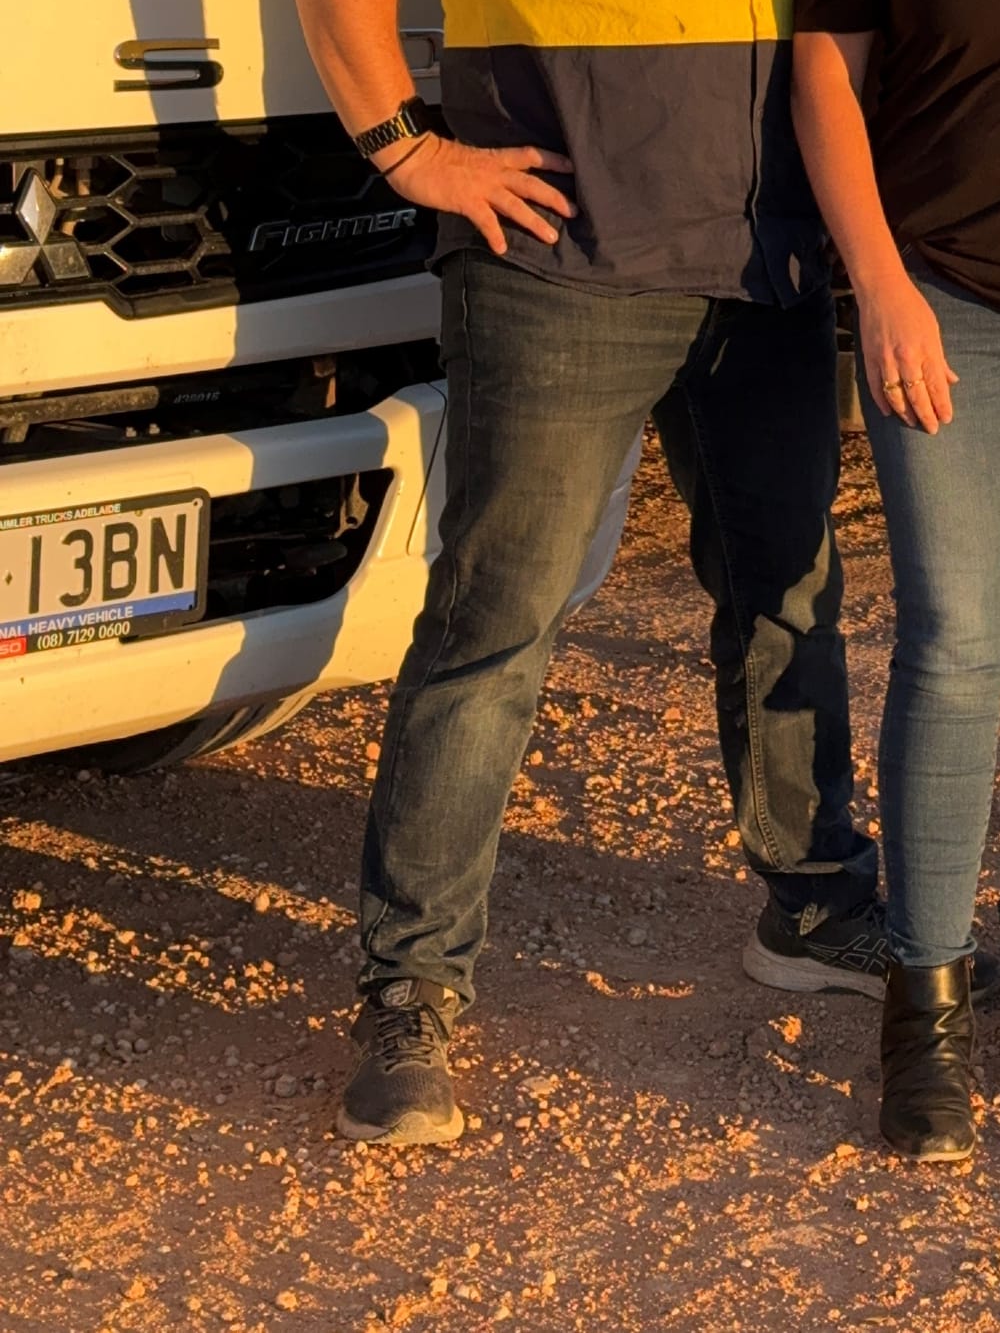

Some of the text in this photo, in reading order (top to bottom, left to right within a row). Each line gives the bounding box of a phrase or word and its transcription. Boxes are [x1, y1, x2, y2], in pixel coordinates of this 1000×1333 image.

[35, 510, 73, 525] TRUCKS
[73, 503, 122, 520] ADELAIDE
[28, 616, 76, 635] HEAVY
[78, 606, 134, 626] VEHICLE
[37, 620, 131, 650] (08) 7129 0600
